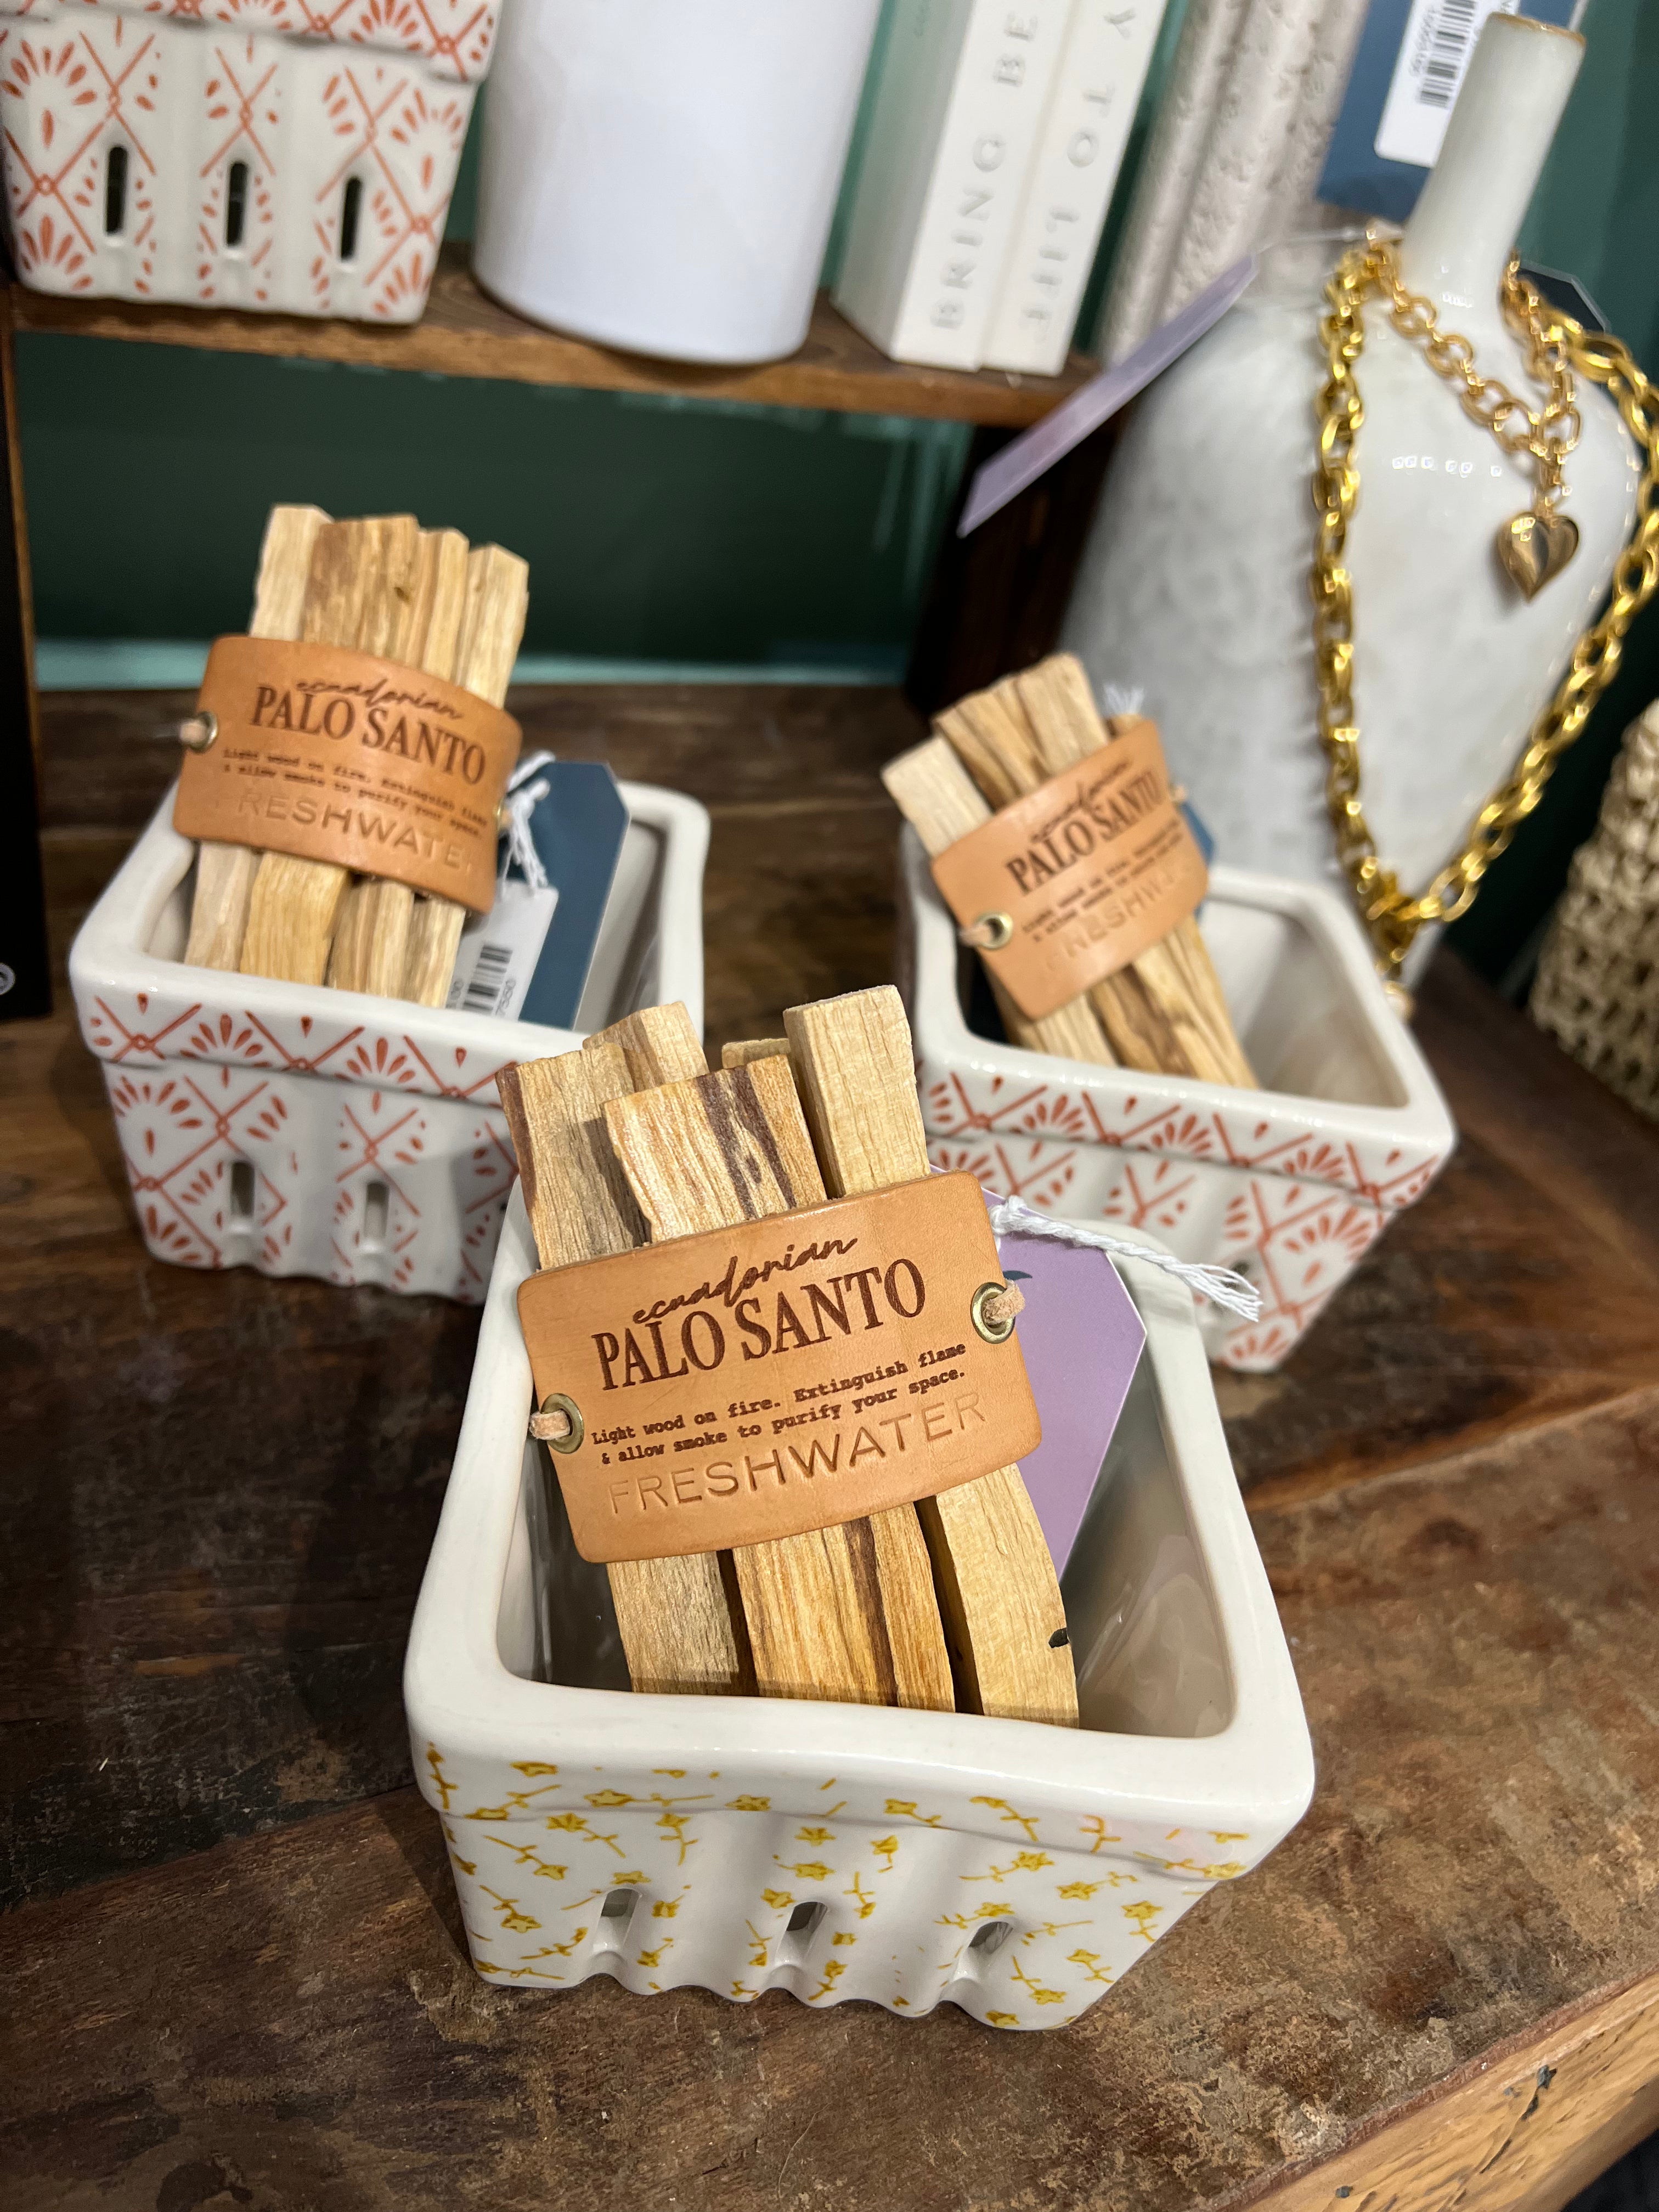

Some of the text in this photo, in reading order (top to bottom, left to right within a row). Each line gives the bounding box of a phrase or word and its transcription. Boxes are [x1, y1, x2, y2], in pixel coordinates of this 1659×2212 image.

[1066, 83, 1115, 167] TO
[931, 133, 1006, 330] BRING
[248, 685, 485, 785] PALO SANTO
[1006, 820, 1094, 896] PALO
[591, 1258, 926, 1390] PALO SANTO
[633, 1238, 858, 1324] ecuadorian
[591, 1343, 966, 1444] Light wood on fire. Extinguish flame
[601, 1368, 965, 1464] & allow smoke to purify your space.
[609, 1392, 986, 1514] FRESHWATER
